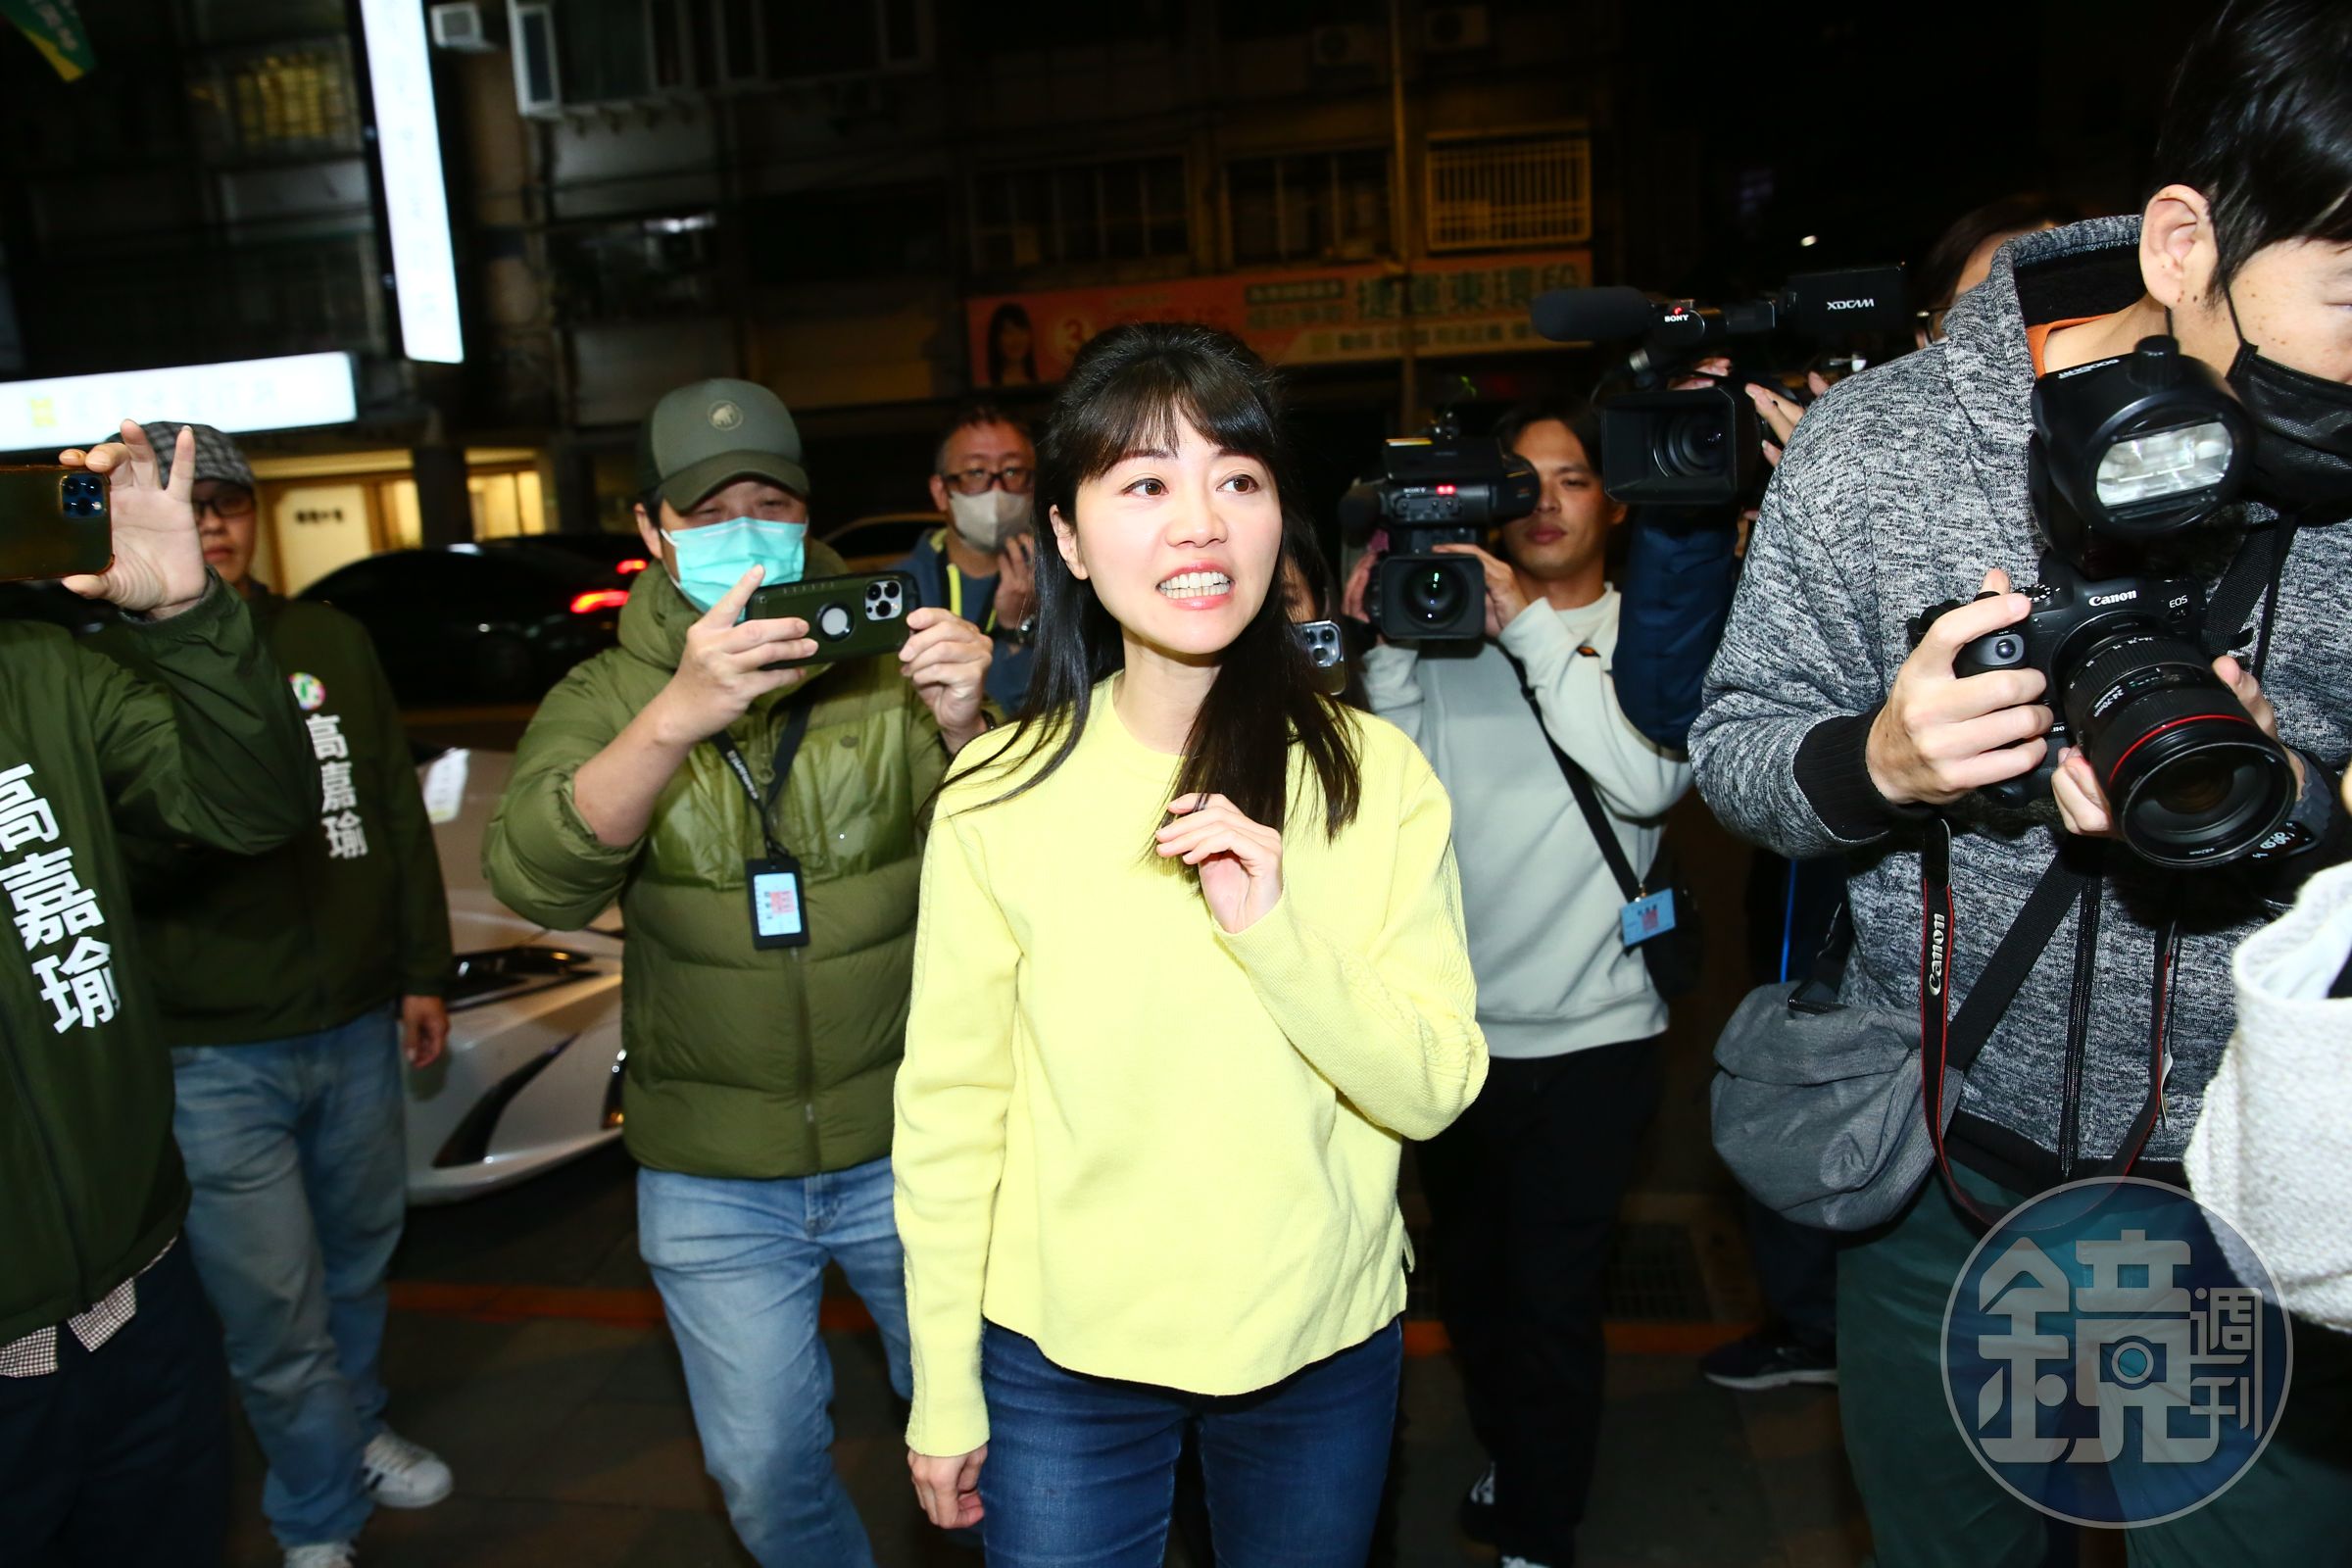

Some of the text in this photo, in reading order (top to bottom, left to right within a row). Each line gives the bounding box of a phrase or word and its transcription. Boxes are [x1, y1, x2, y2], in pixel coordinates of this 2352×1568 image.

[1826, 298, 1875, 311] XDCAM
[1664, 314, 1690, 323] SONY
[2088, 590, 2137, 607] Canon
[2169, 595, 2188, 609] EOS
[305, 712, 368, 858] 高嘉瑜
[0, 763, 122, 1034] 高嘉瑜
[1929, 912, 1945, 997] Canon
